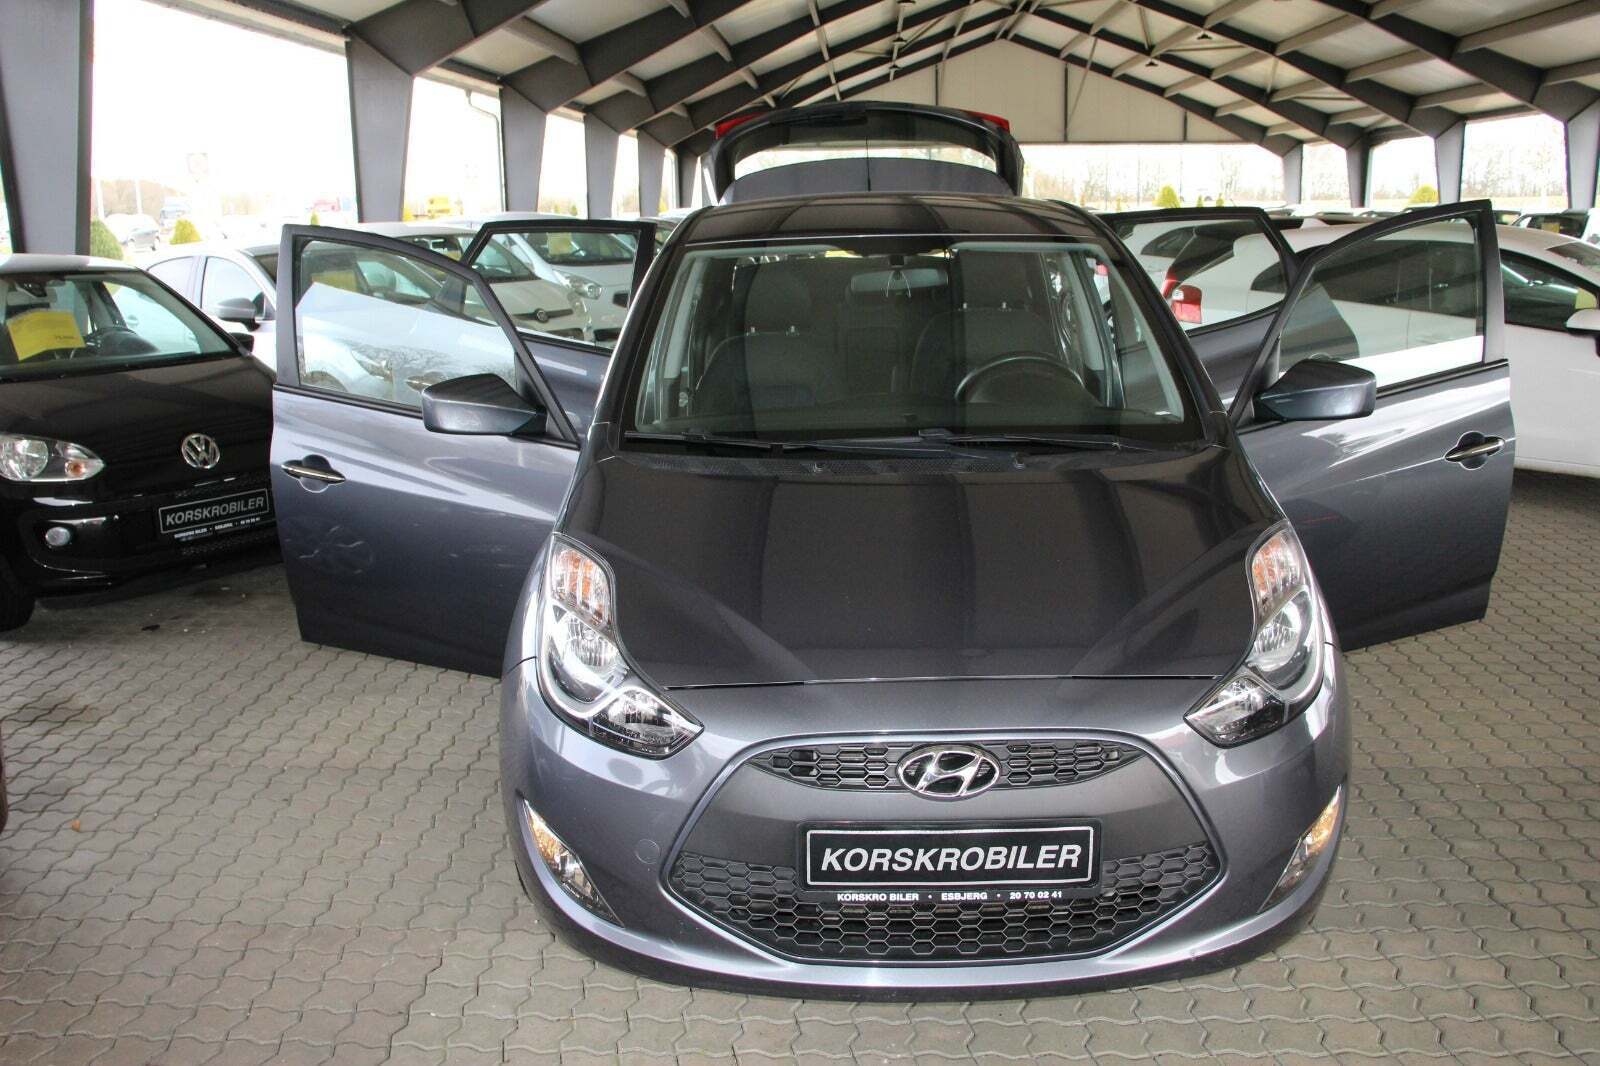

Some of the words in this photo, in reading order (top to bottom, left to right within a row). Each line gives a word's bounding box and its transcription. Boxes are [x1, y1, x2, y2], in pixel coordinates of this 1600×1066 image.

[166, 496, 264, 526] KORSKROBILER
[821, 844, 1082, 872] KORSKROBILER
[837, 893, 887, 902] KORSKRO
[889, 892, 919, 901] BILER
[941, 892, 988, 901] ESBJERG
[1009, 892, 1021, 900] 20
[1023, 891, 1036, 899] 70
[1037, 891, 1050, 899] 02
[1051, 890, 1063, 898] 41
